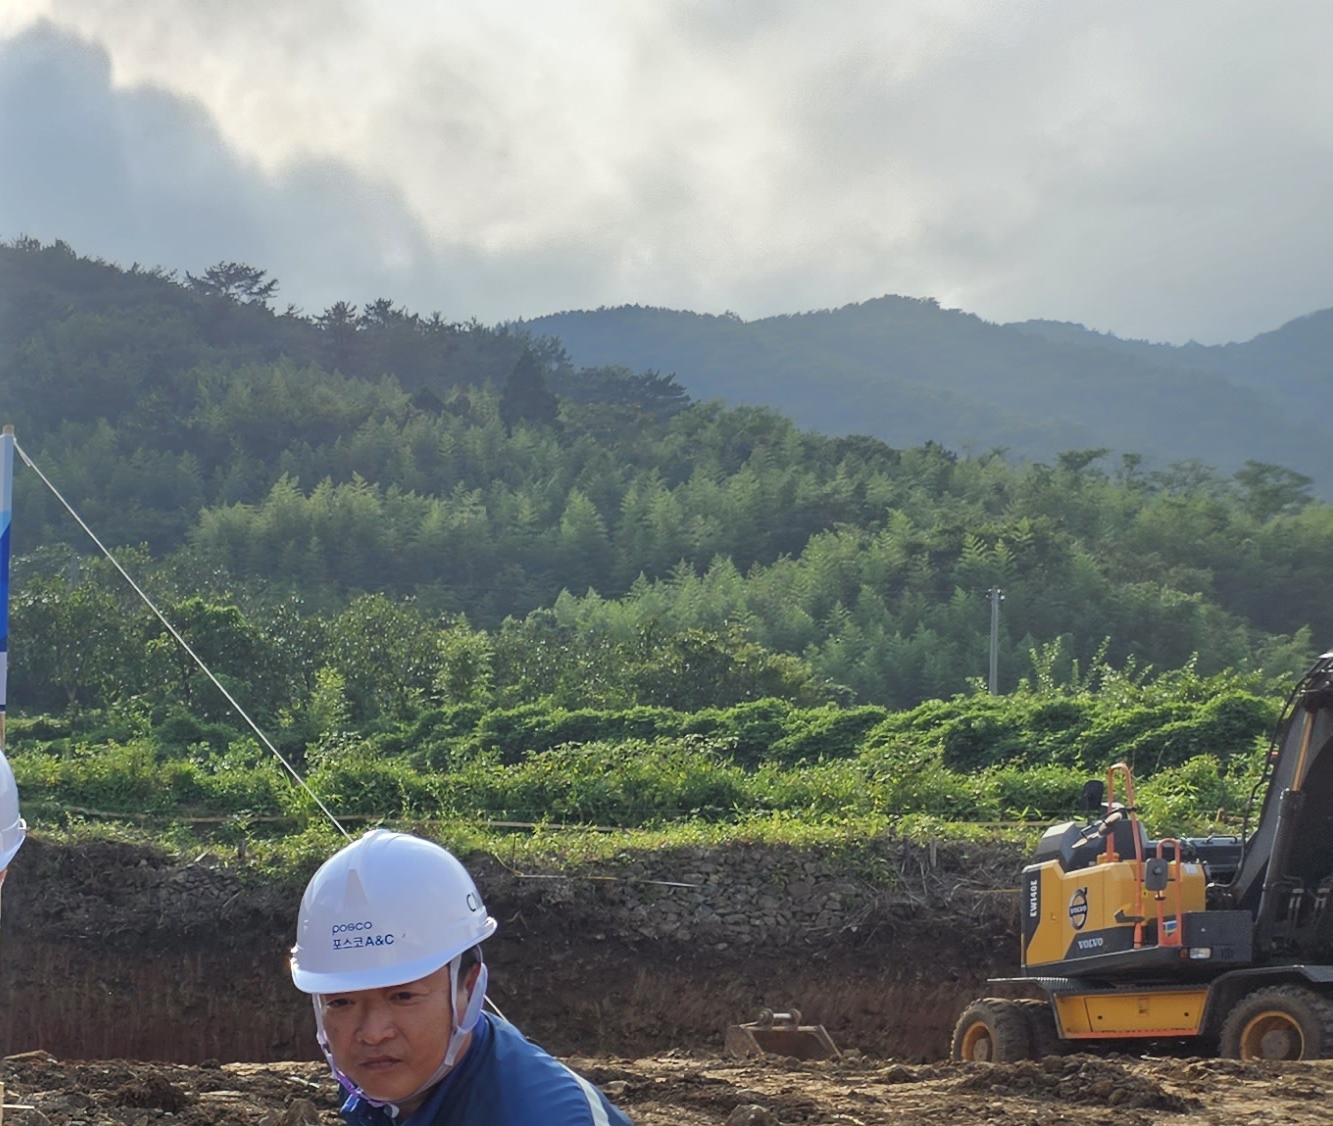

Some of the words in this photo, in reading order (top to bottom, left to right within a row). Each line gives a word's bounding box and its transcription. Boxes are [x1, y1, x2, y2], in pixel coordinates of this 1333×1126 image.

[332, 921, 372, 936] posco
[333, 934, 395, 950] 포스코A&C
[1078, 937, 1104, 950] VOLVO
